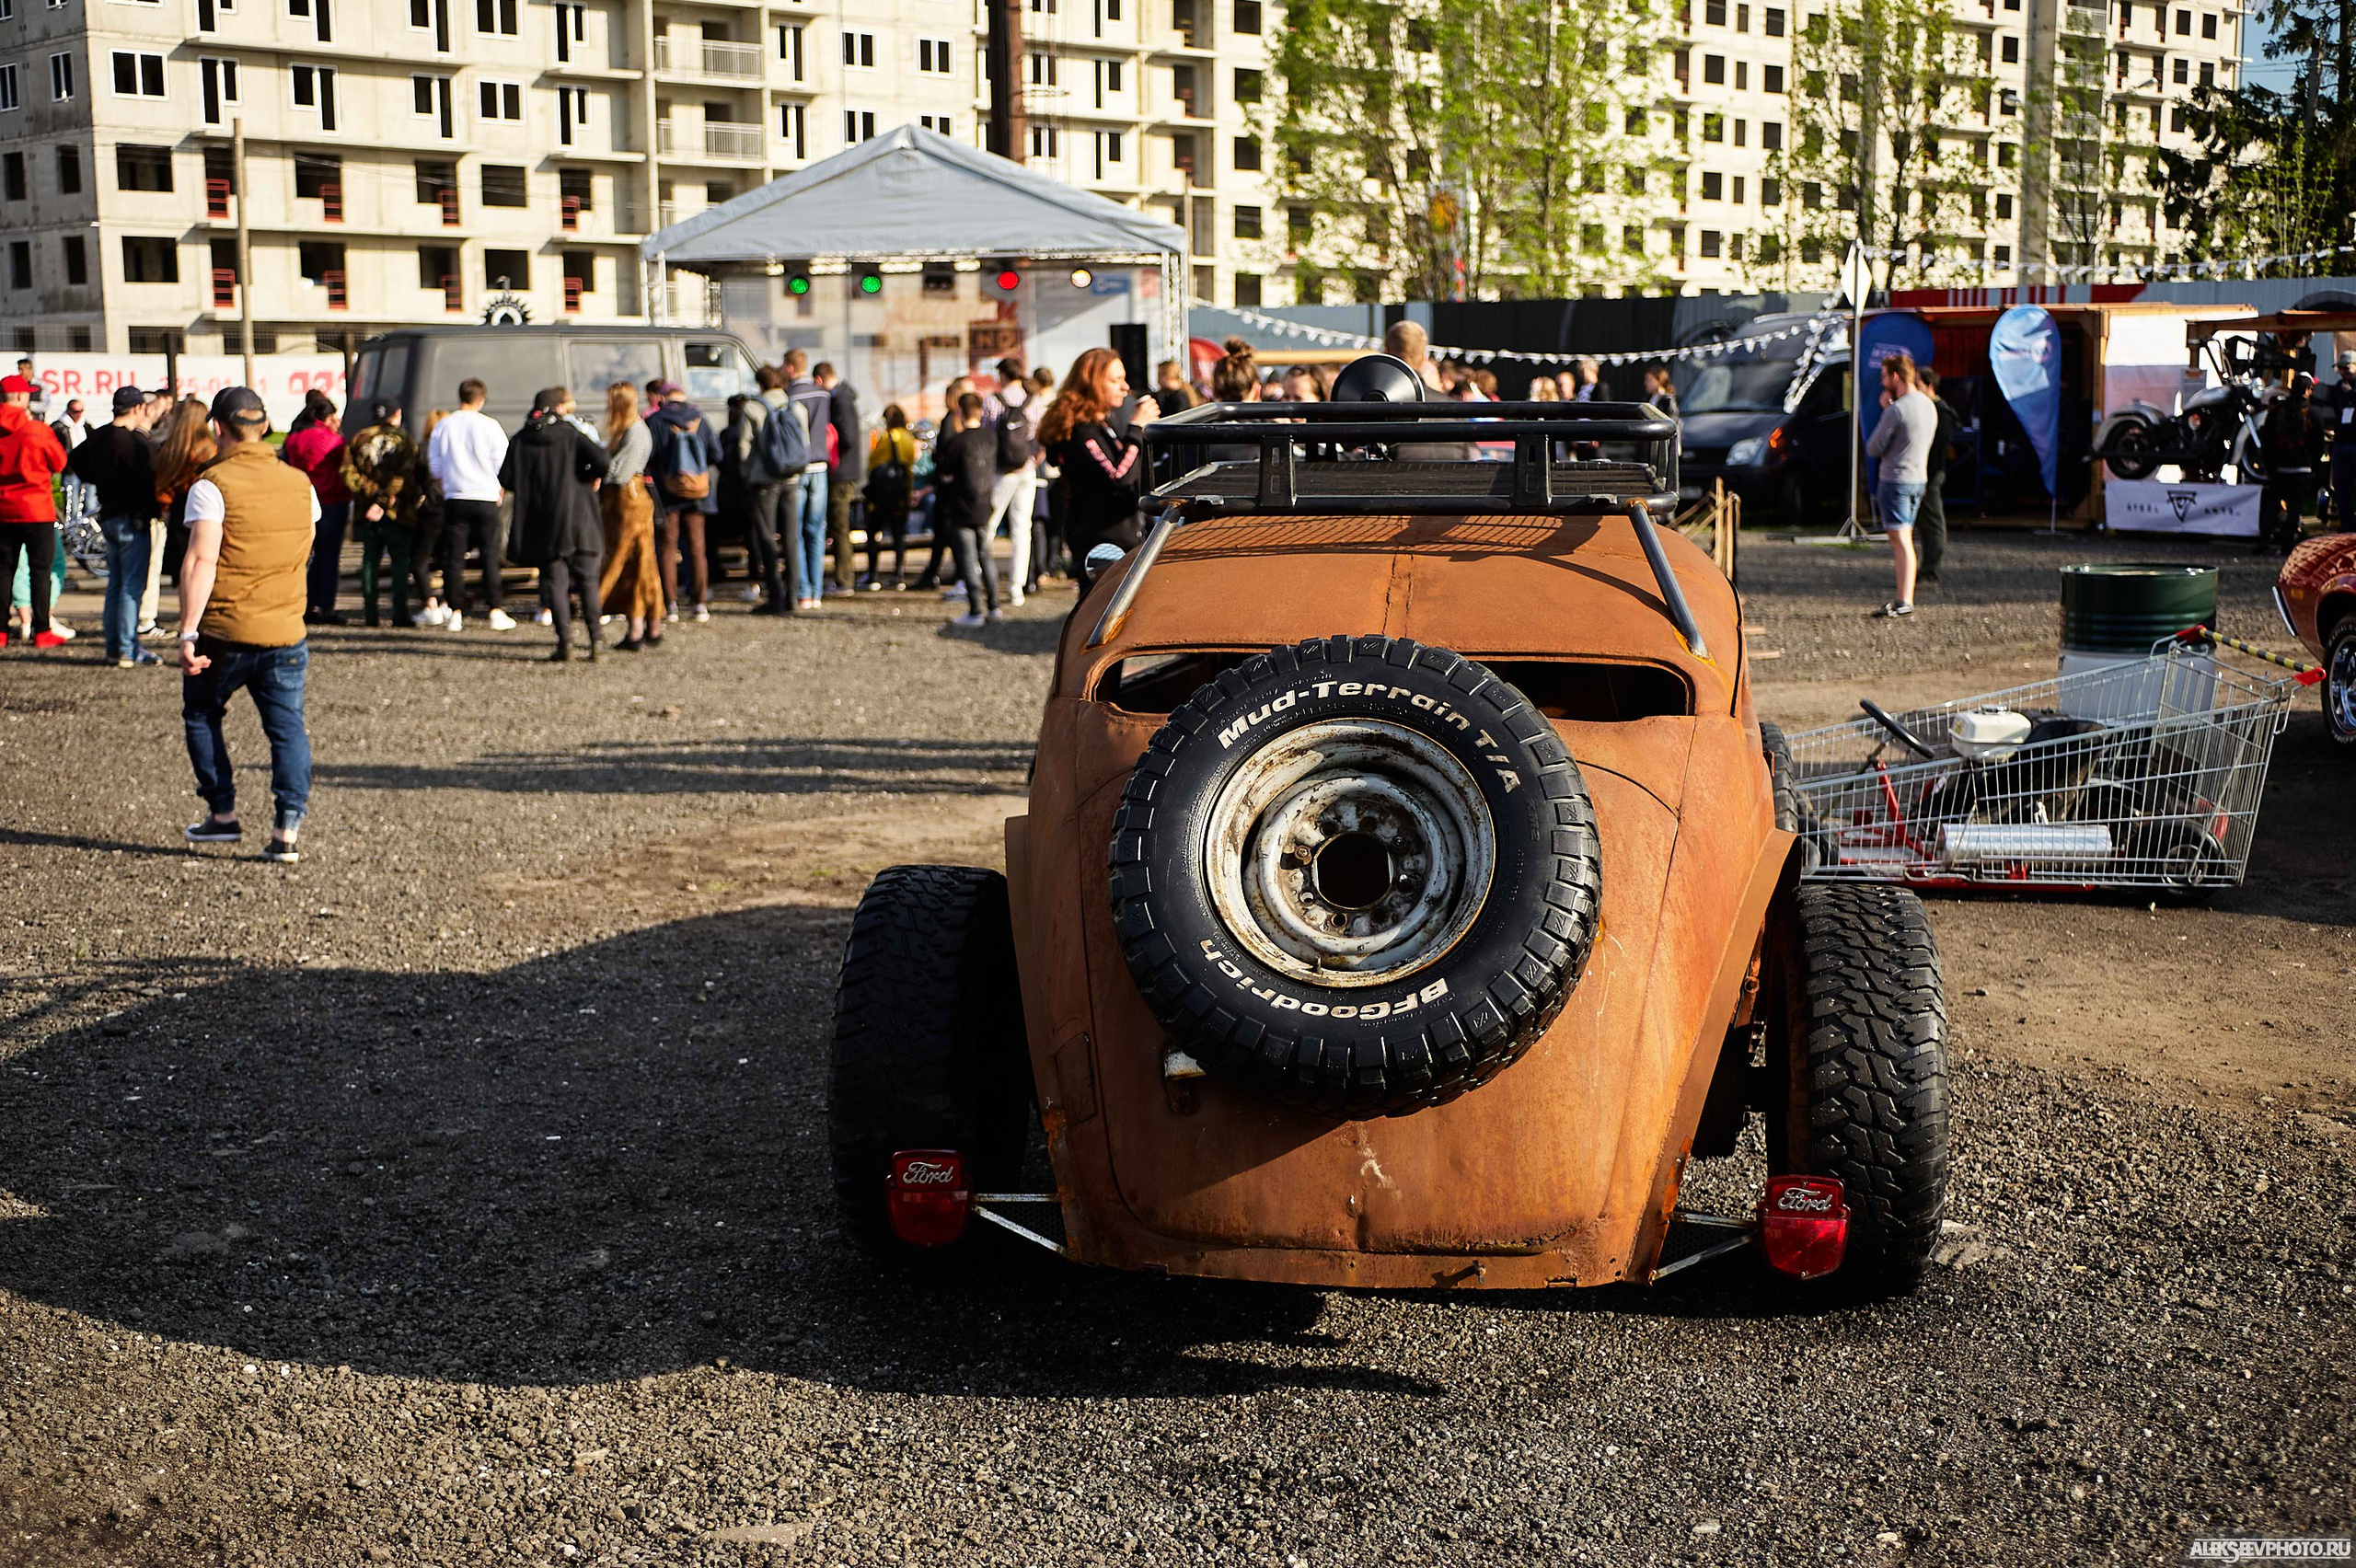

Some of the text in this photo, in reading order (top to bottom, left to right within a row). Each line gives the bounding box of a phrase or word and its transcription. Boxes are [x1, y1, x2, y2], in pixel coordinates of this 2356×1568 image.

[1218, 681, 1471, 749] Mud-Terrain
[1474, 729, 1520, 793] T/A
[1200, 939, 1449, 1020] BFGoodrich
[903, 1161, 953, 1183] Ford
[1778, 1187, 1832, 1212] Ford
